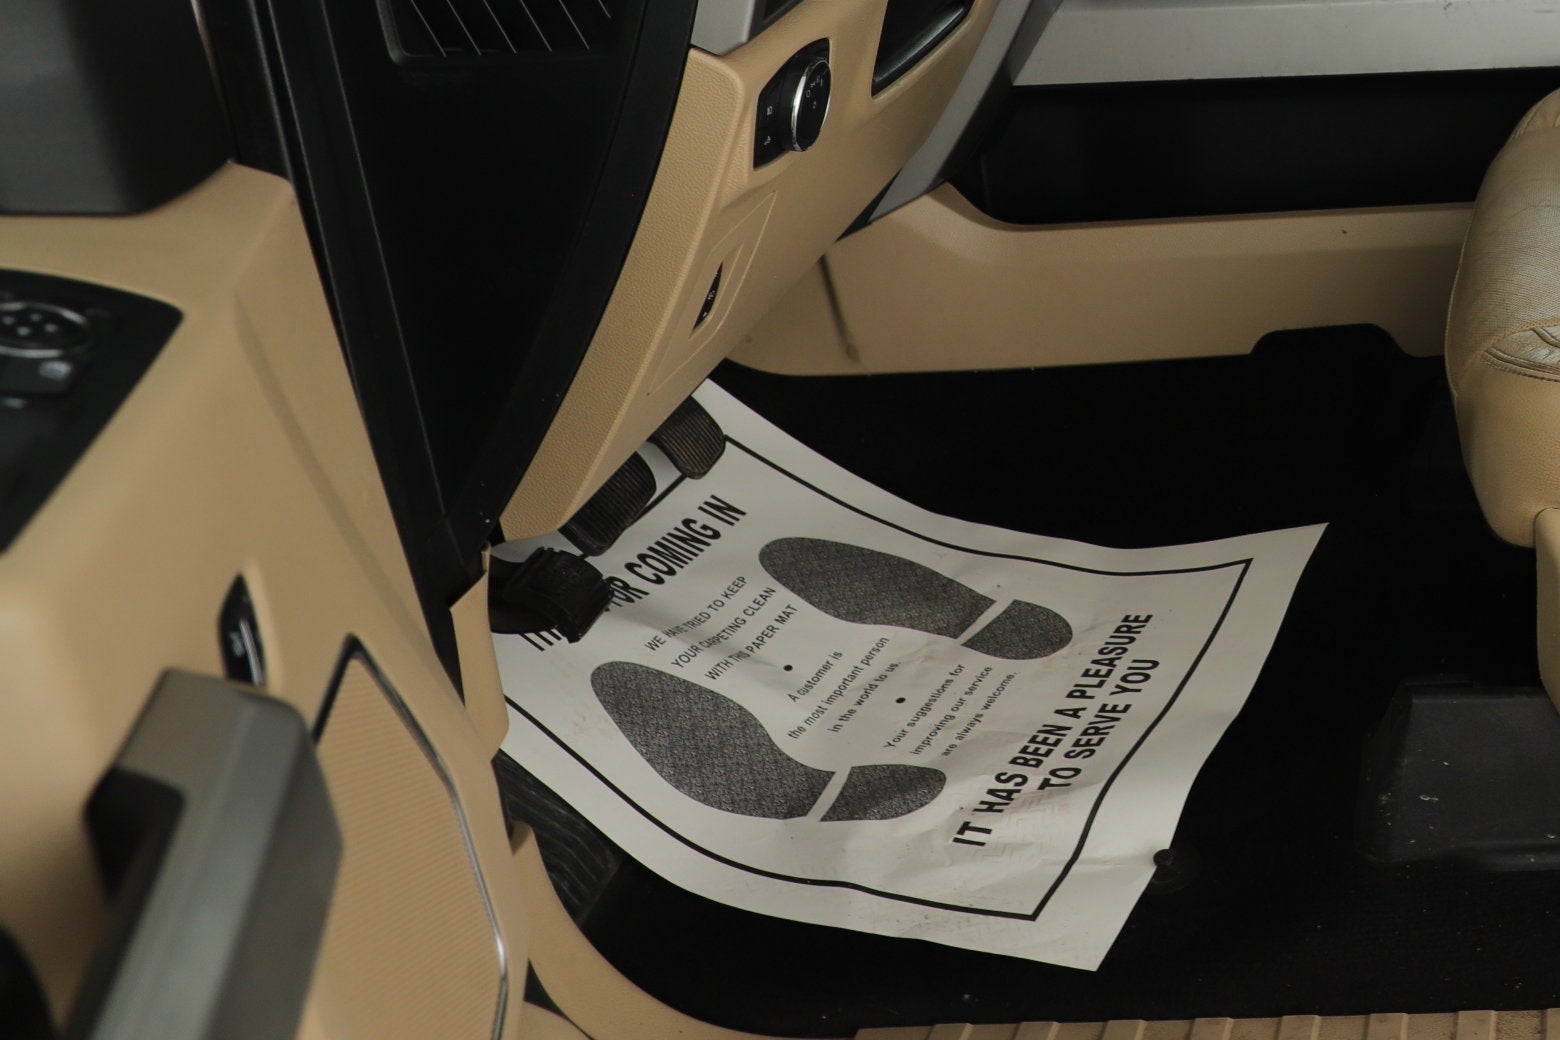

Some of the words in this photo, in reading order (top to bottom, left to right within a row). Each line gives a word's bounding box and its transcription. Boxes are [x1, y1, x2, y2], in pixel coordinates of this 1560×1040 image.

[624, 518, 721, 585] COMING
[697, 494, 747, 526] IN
[644, 635, 666, 652] WE
[682, 611, 711, 631] TRIED
[707, 599, 725, 612] TO
[721, 576, 748, 600] KEEP
[671, 644, 704, 669] YOUR
[700, 617, 747, 649] CARPETING
[743, 587, 777, 617] CLEAN
[704, 660, 735, 681] WITH
[745, 624, 780, 654] PAPER
[774, 604, 799, 625] MAT
[787, 693, 800, 703] A
[796, 660, 834, 696] customer
[829, 651, 843, 661] is
[787, 726, 807, 739] the
[804, 705, 828, 726] most
[821, 665, 864, 706] important
[860, 637, 890, 667] person
[838, 708, 857, 721] the
[853, 683, 879, 707] world
[873, 674, 888, 682] to
[885, 661, 902, 673] us.
[1065, 614, 1153, 699] PLEASURE
[883, 729, 909, 748] Your
[906, 678, 954, 728] suggestions
[949, 664, 966, 677] for
[909, 713, 956, 756] improving
[951, 698, 967, 713] our
[964, 666, 993, 696] service
[941, 743, 958, 756] are
[955, 713, 984, 741] always
[981, 671, 1018, 712] welcome.
[1037, 767, 1082, 791] TO
[1063, 703, 1132, 759] SERVE
[1109, 659, 1160, 696] YOU
[1053, 707, 1087, 719] A
[1008, 724, 1073, 768] BEEN
[972, 772, 1029, 813] HAS
[952, 821, 993, 847] IT
